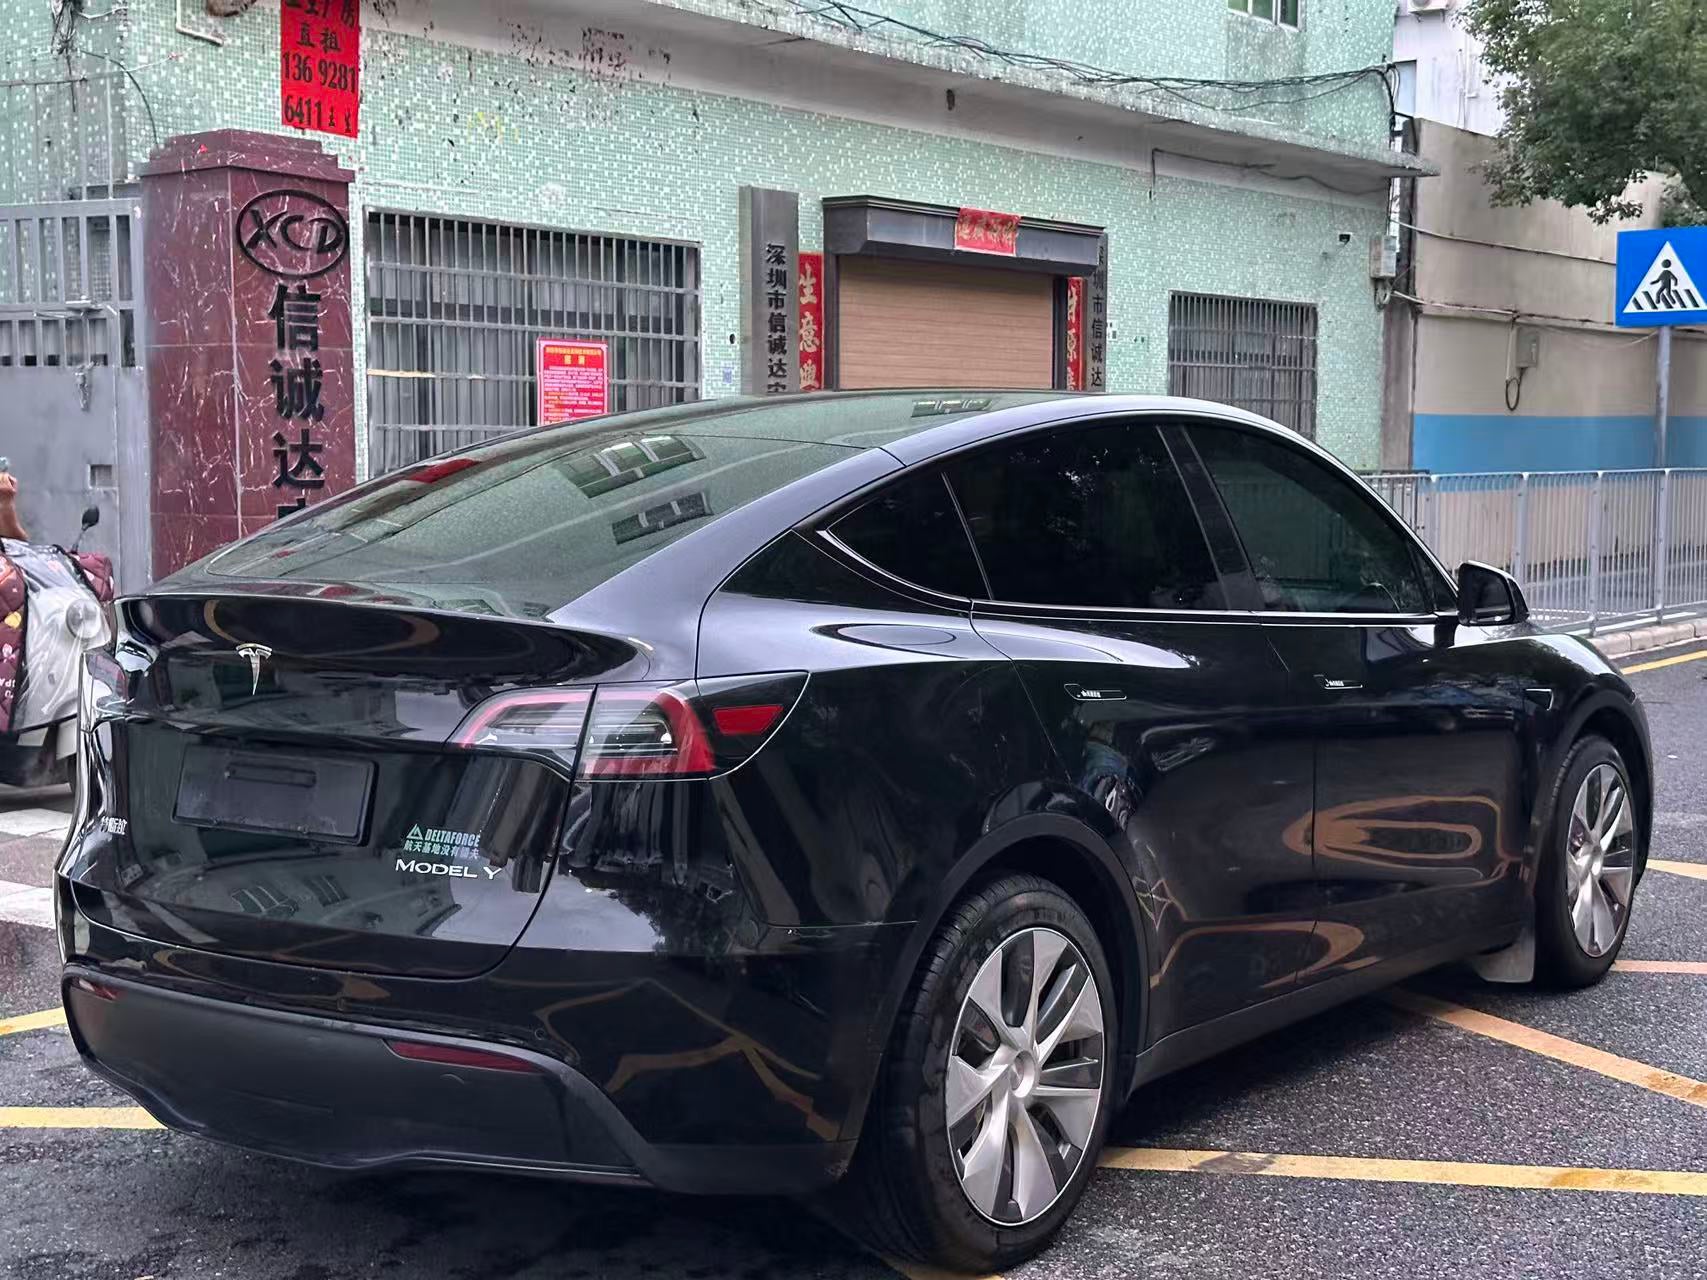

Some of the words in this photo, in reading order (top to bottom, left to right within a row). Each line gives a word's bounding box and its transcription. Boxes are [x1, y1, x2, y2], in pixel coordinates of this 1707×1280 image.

[283, 51, 312, 83] 136
[319, 59, 355, 94] 9281
[285, 95, 321, 128] 6411
[395, 858, 478, 878] MODEL
[482, 866, 502, 880] Y
